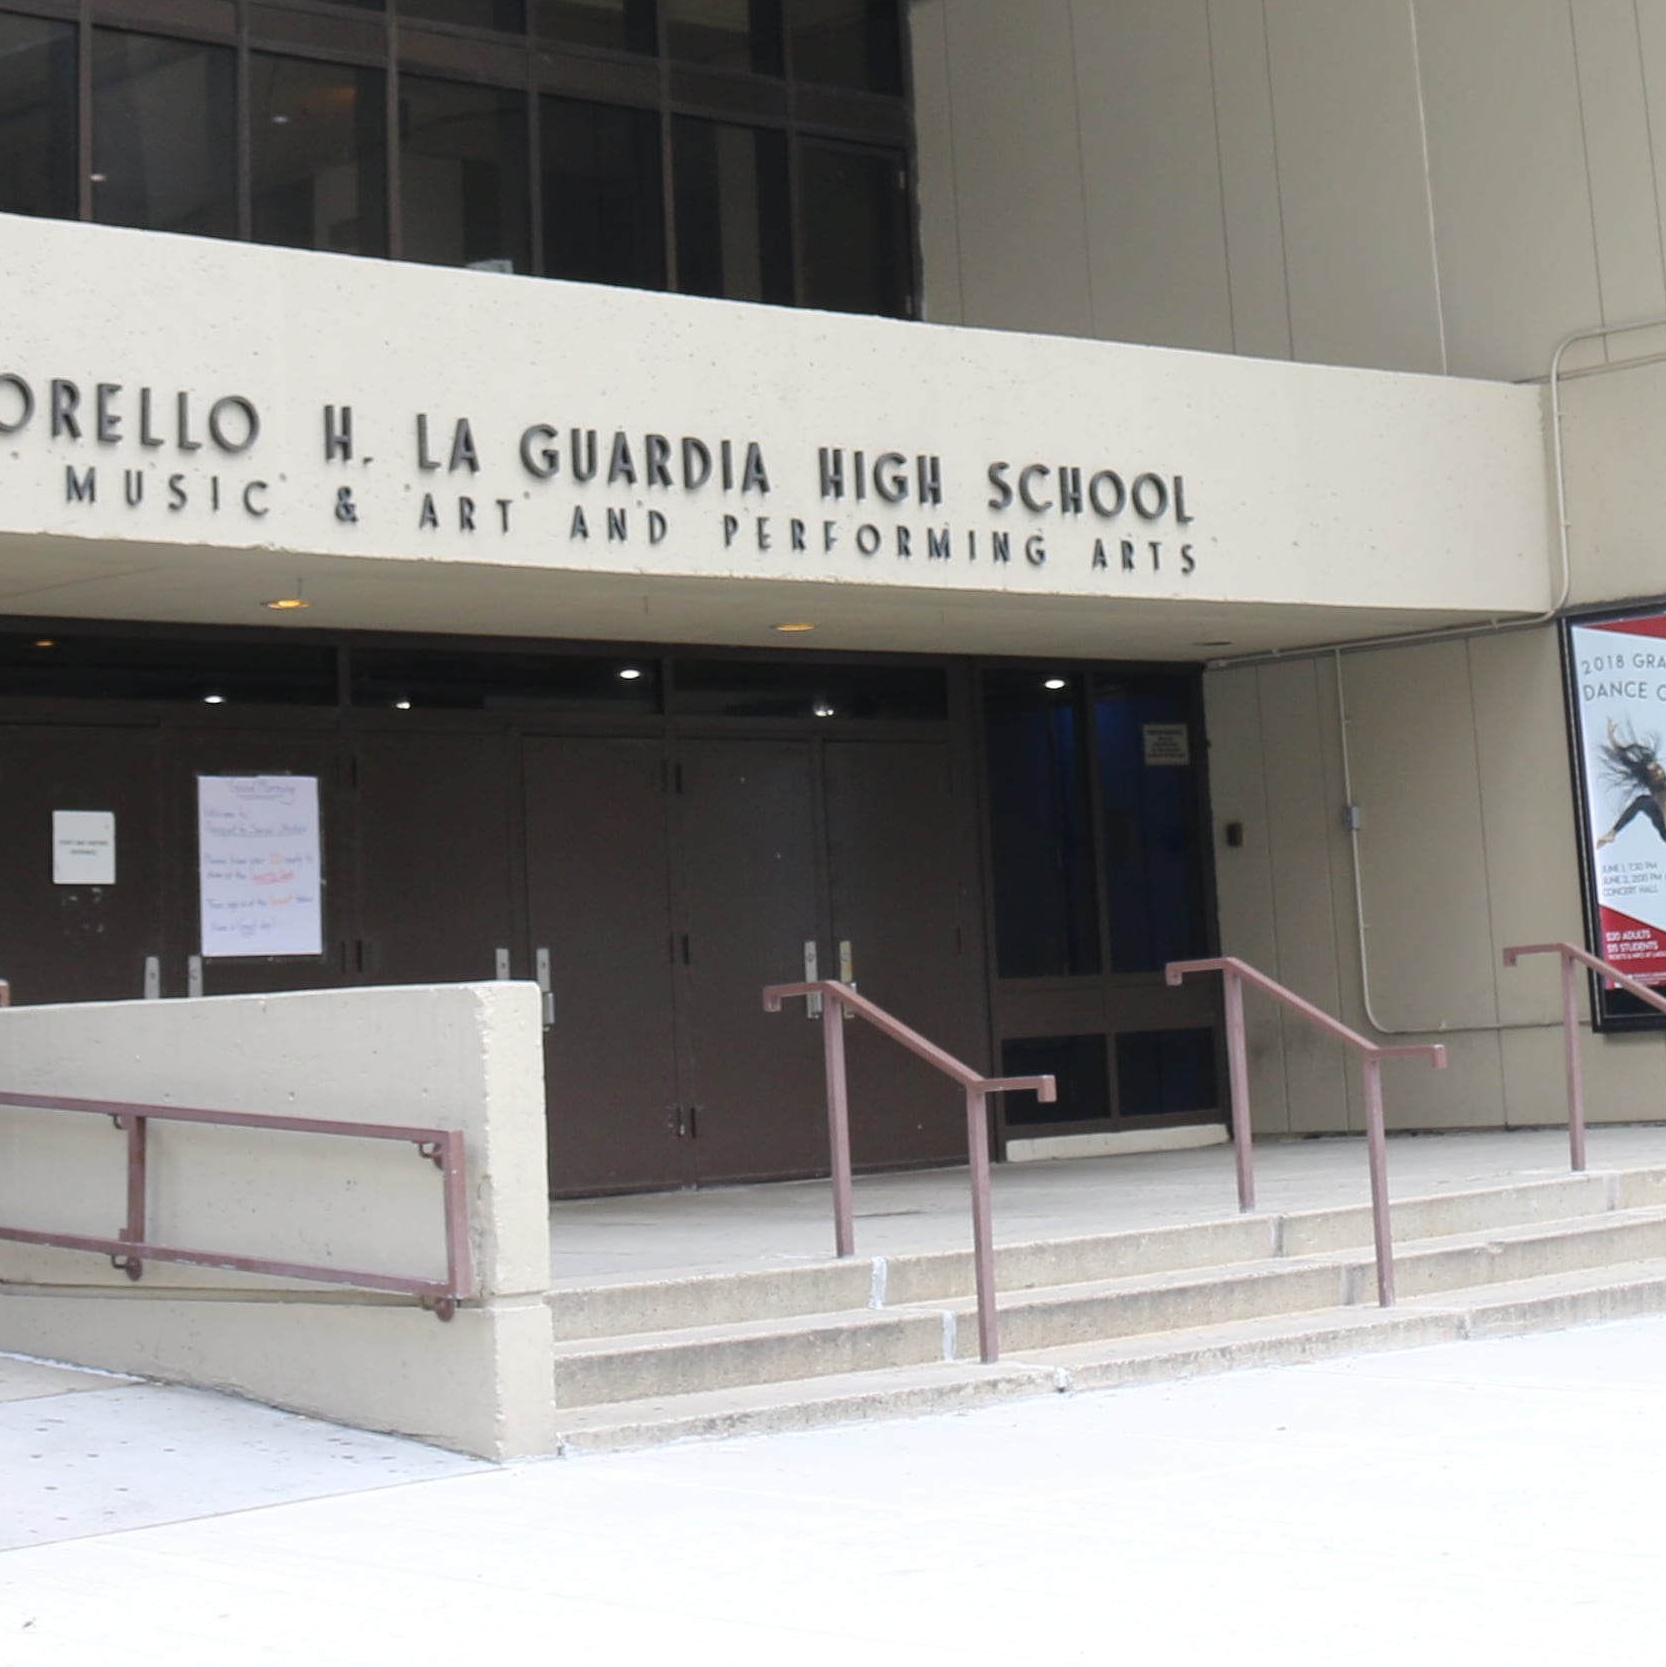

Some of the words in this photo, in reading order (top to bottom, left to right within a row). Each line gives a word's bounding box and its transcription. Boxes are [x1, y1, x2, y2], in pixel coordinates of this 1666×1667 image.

[323, 404, 374, 465] H.
[415, 412, 481, 475] LA
[519, 423, 771, 496] GUARDIA
[818, 446, 944, 506] HIGH
[987, 459, 1195, 525] SCHOOL
[64, 464, 271, 518] MUSIC
[333, 485, 359, 524] &
[418, 491, 514, 534] ART
[569, 504, 669, 546] AND
[722, 512, 1048, 568] PERFORMING
[1090, 538, 1197, 576] ARTS
[1581, 653, 1625, 676] 2018
[1582, 680, 1649, 702] DANCE
